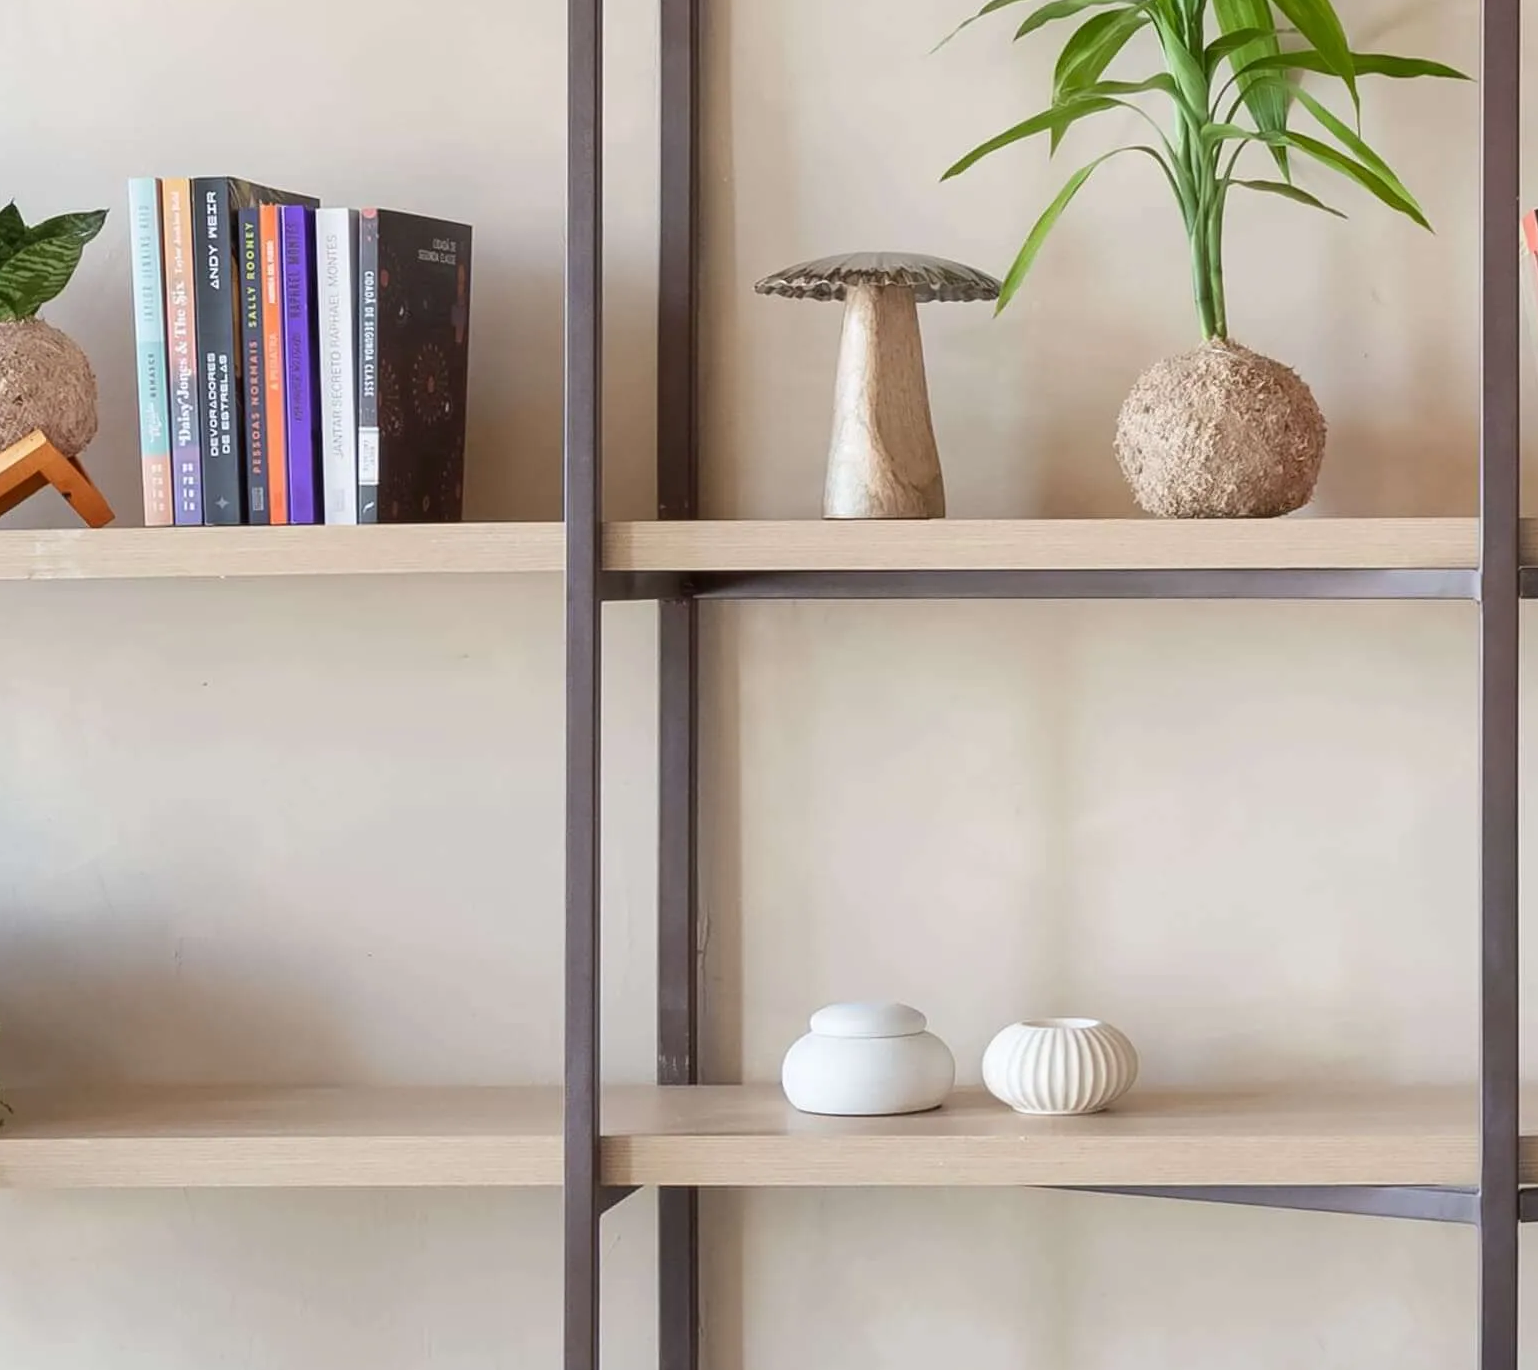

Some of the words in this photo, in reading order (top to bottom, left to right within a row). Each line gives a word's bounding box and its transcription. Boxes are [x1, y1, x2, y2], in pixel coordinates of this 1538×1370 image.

[206, 191, 219, 239] WEIR
[207, 244, 220, 290] ANDY
[244, 223, 255, 280] ROONEY
[326, 234, 339, 288] MONTES
[171, 281, 188, 305] Six
[247, 287, 257, 328] SALLY
[364, 271, 376, 304] CIDADÃ
[173, 308, 187, 336] The
[328, 293, 341, 348] RAPHAEL
[364, 306, 374, 318] DE
[175, 341, 188, 354] &
[364, 319, 375, 361] SEGUNDA
[176, 357, 192, 401] Jones
[219, 354, 231, 431] ESTRELAS
[248, 340, 260, 406] NORMAIS
[331, 351, 343, 407] SECRETO
[364, 364, 375, 397] CLASSE
[177, 399, 193, 447] Daisy
[206, 352, 219, 457] DEVORADORES
[221, 434, 231, 454] DE
[251, 412, 262, 474] PESSOAS
[332, 408, 344, 460] JANTAR
